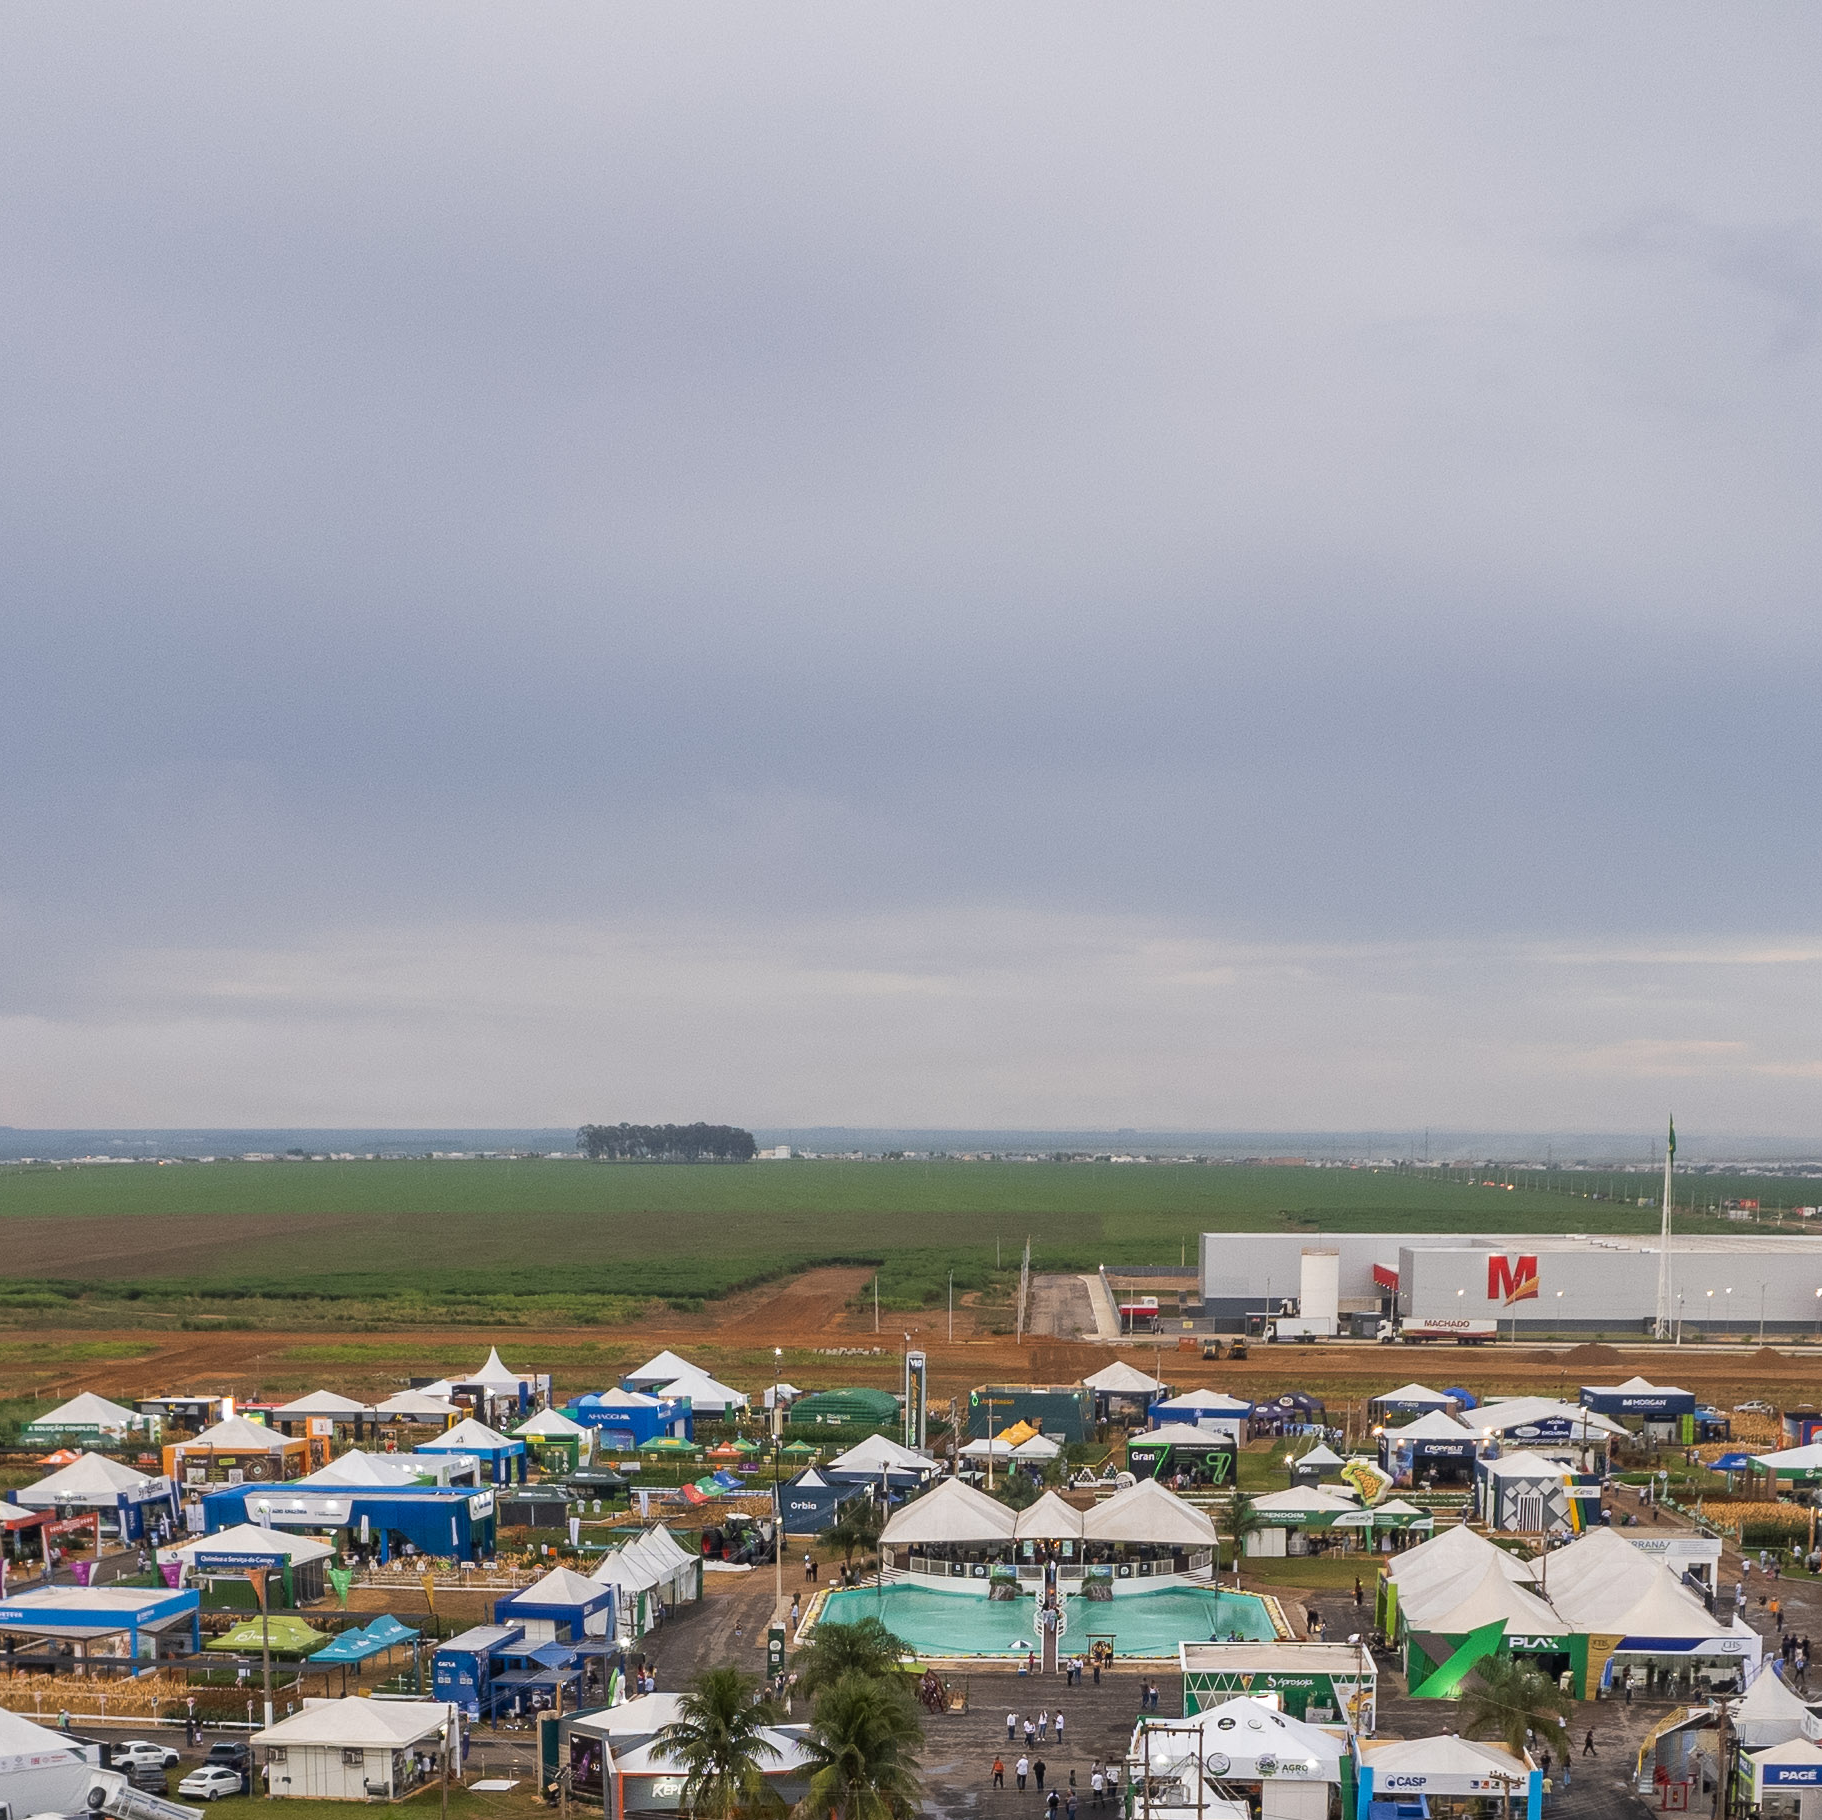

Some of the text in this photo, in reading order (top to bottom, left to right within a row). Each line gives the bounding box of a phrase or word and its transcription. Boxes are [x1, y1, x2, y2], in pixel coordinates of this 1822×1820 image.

[1424, 1319, 1470, 1328] MACHADO
[34, 1424, 61, 1433] SOLUÇÃO
[790, 1501, 817, 1511] Orbia
[1509, 1637, 1559, 1649] PLAX
[1722, 1640, 1741, 1649] CHS
[1277, 1676, 1315, 1688] Aprosoja
[1282, 1764, 1308, 1772] AGRO
[1779, 1768, 1817, 1781] PAGÉ
[1396, 1776, 1427, 1786] CASP
